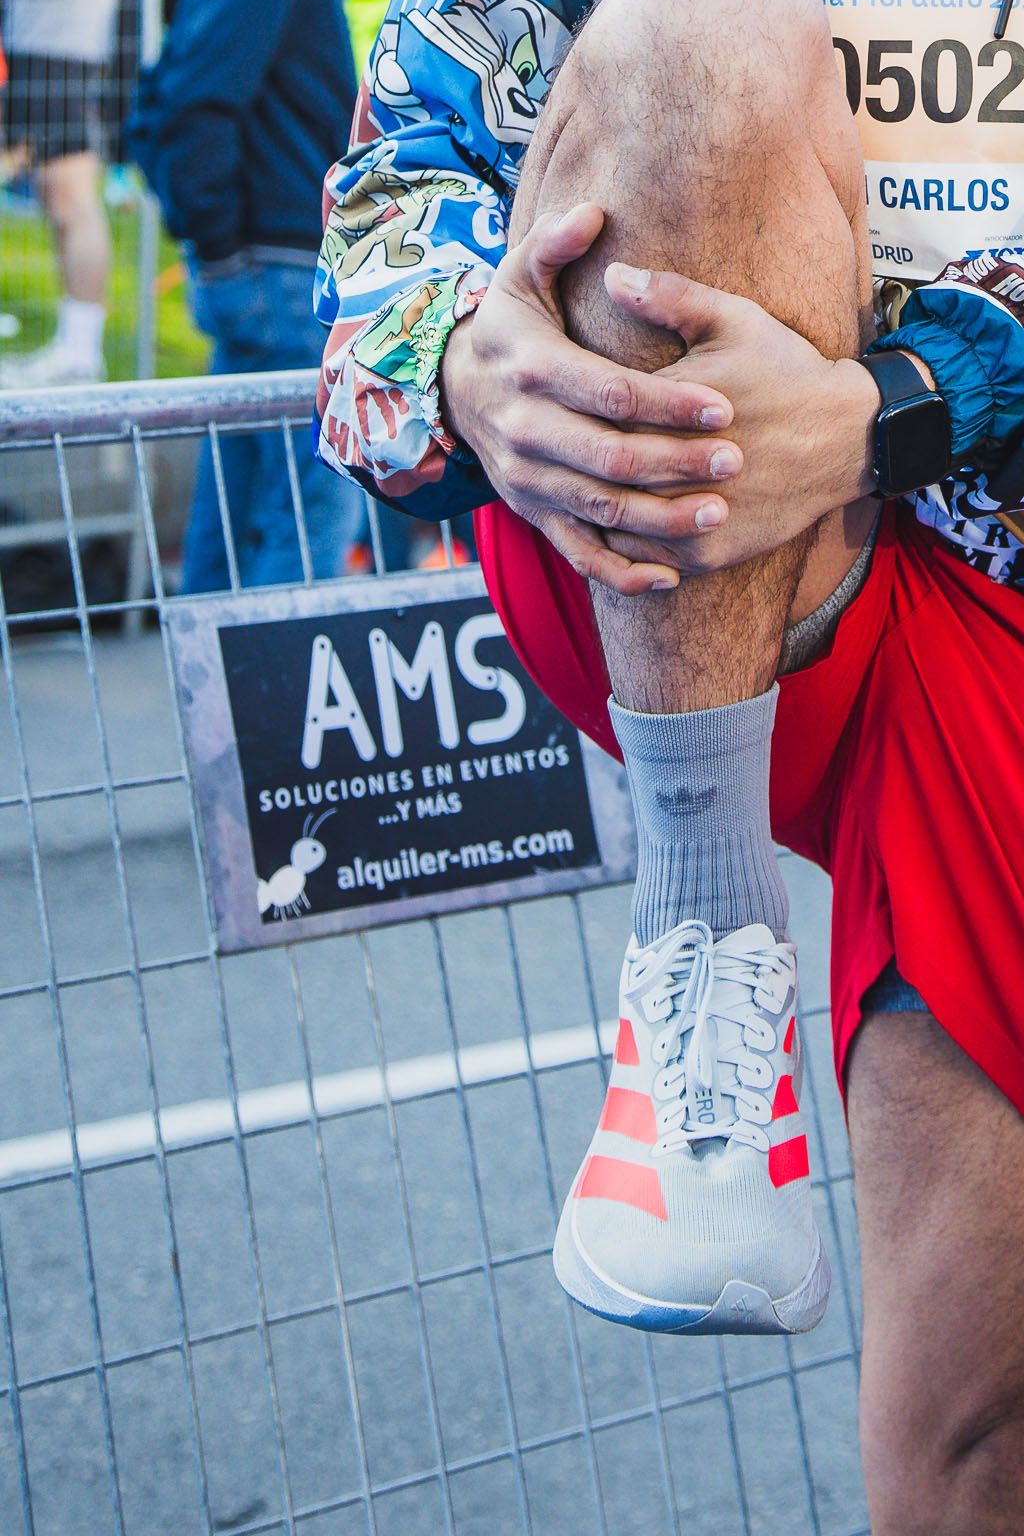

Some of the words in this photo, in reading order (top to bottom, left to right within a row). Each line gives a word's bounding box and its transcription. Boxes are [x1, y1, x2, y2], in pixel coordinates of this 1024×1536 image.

[879, 176, 1010, 213] CARLOS
[301, 613, 527, 770] AMS
[258, 768, 414, 813] SOLUCIONES
[420, 763, 453, 788] EN
[459, 744, 571, 782] EVENTOS
[416, 789, 463, 819] MÁS
[335, 828, 575, 891] alquiler-ms.com
